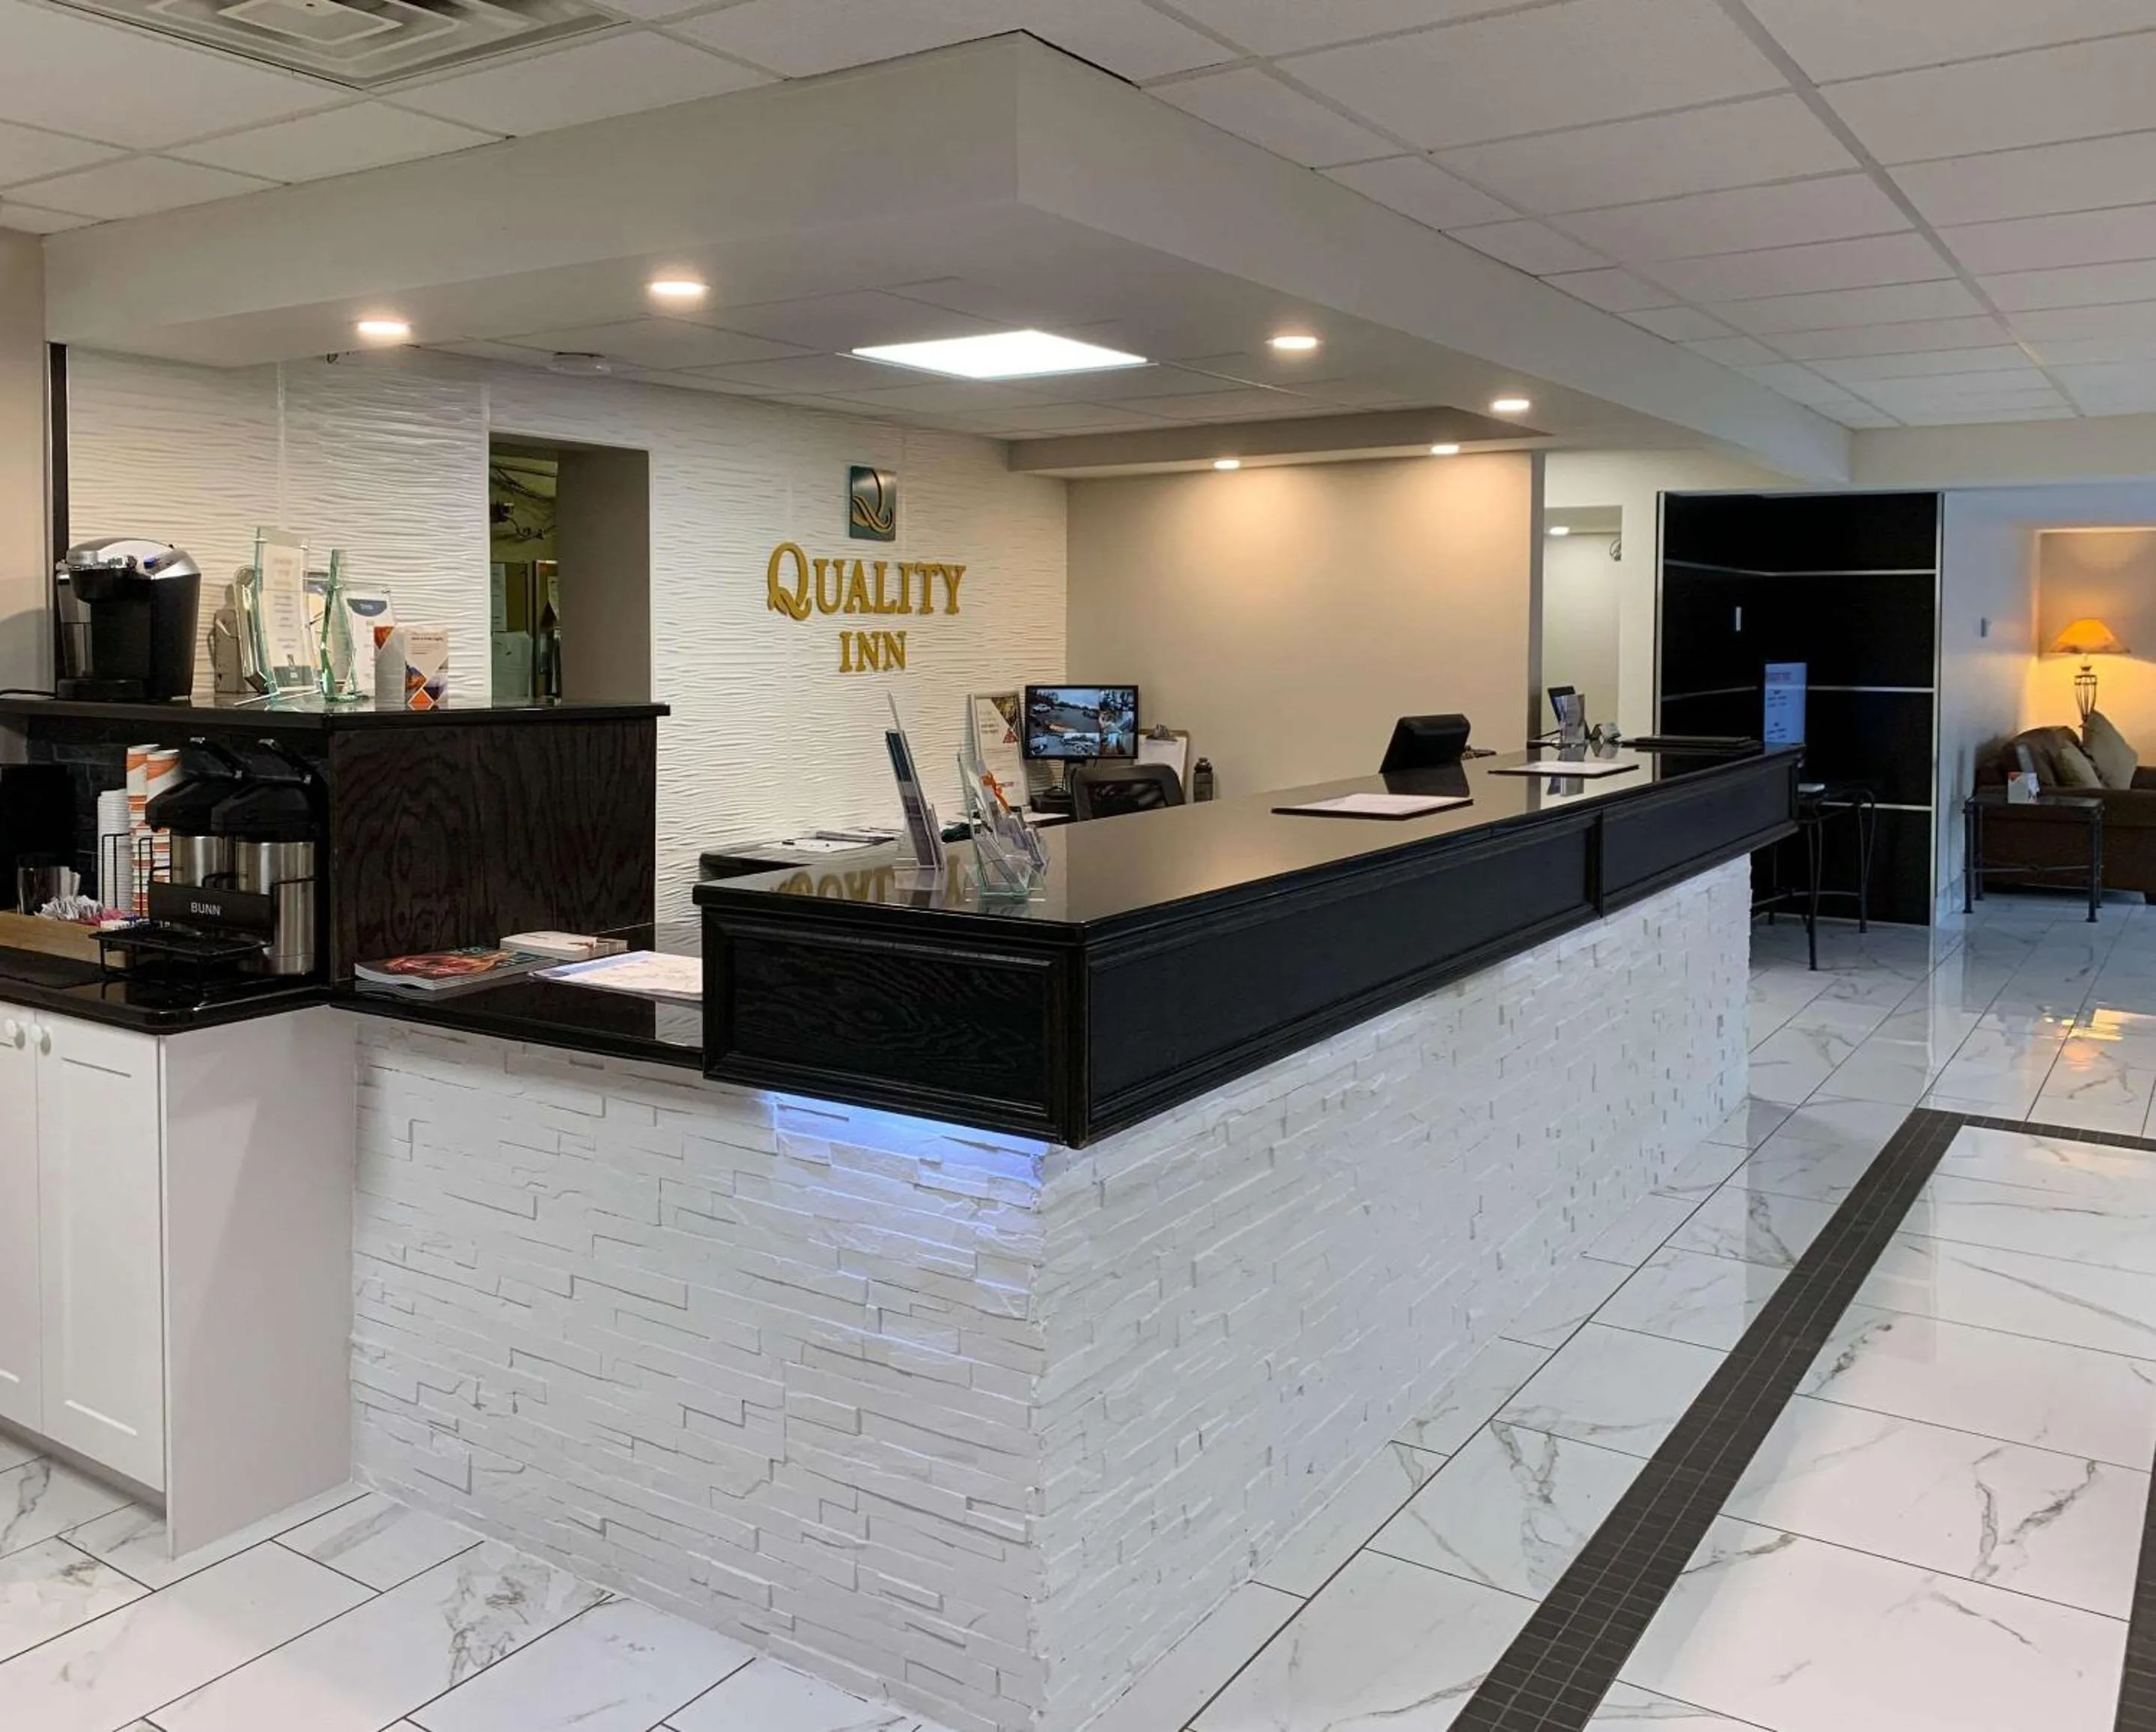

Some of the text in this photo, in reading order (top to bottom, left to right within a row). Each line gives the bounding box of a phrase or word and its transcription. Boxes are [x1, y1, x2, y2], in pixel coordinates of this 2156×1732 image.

[767, 542, 966, 620] QUALITY
[839, 631, 907, 672] INN
[191, 902, 221, 917] BUNN
